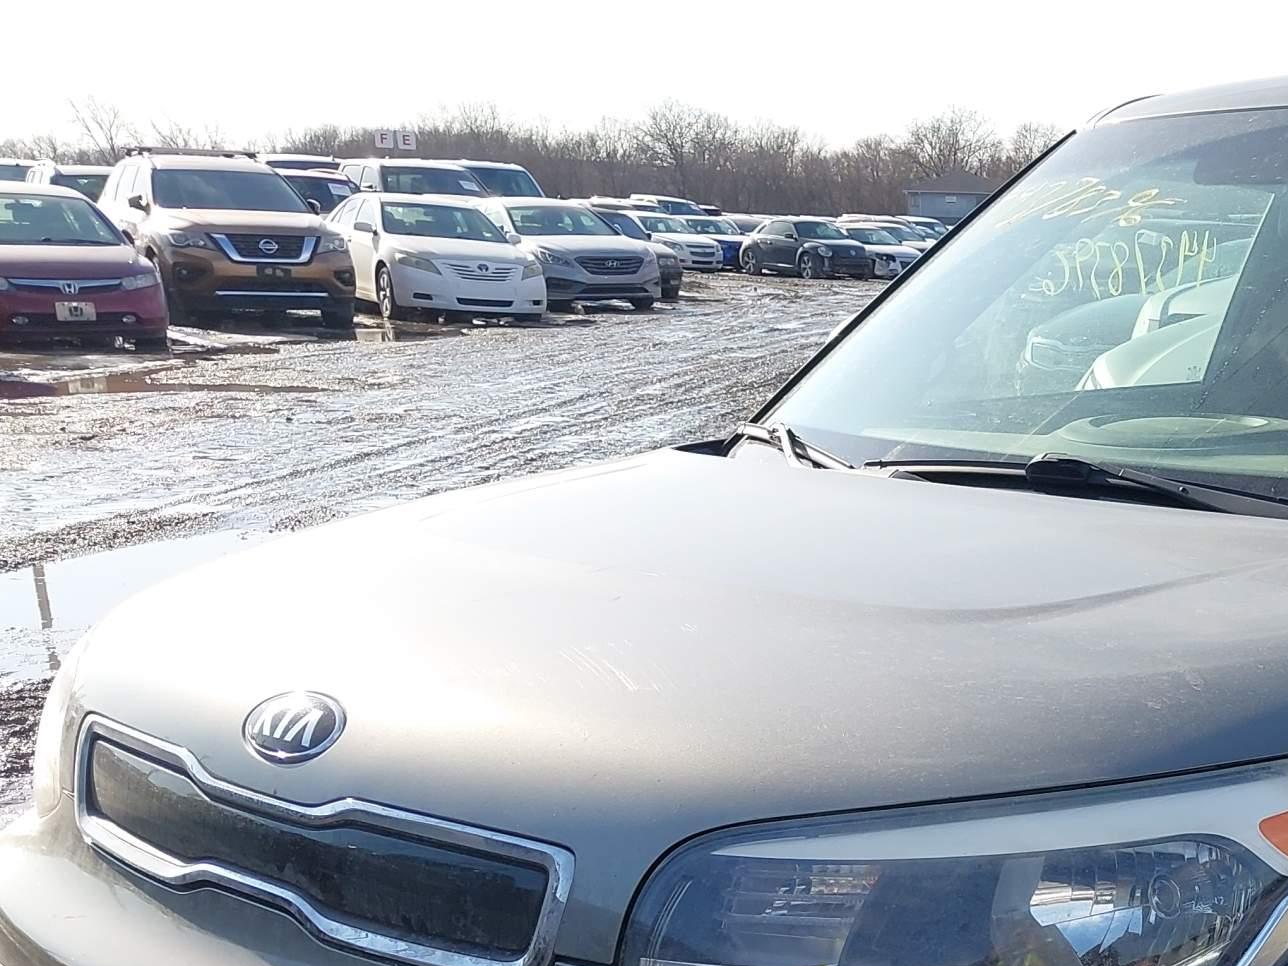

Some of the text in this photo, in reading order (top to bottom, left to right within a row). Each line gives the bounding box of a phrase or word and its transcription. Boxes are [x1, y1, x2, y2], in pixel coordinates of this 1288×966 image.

[380, 133, 411, 146] F E
[252, 706, 325, 748] KIA
